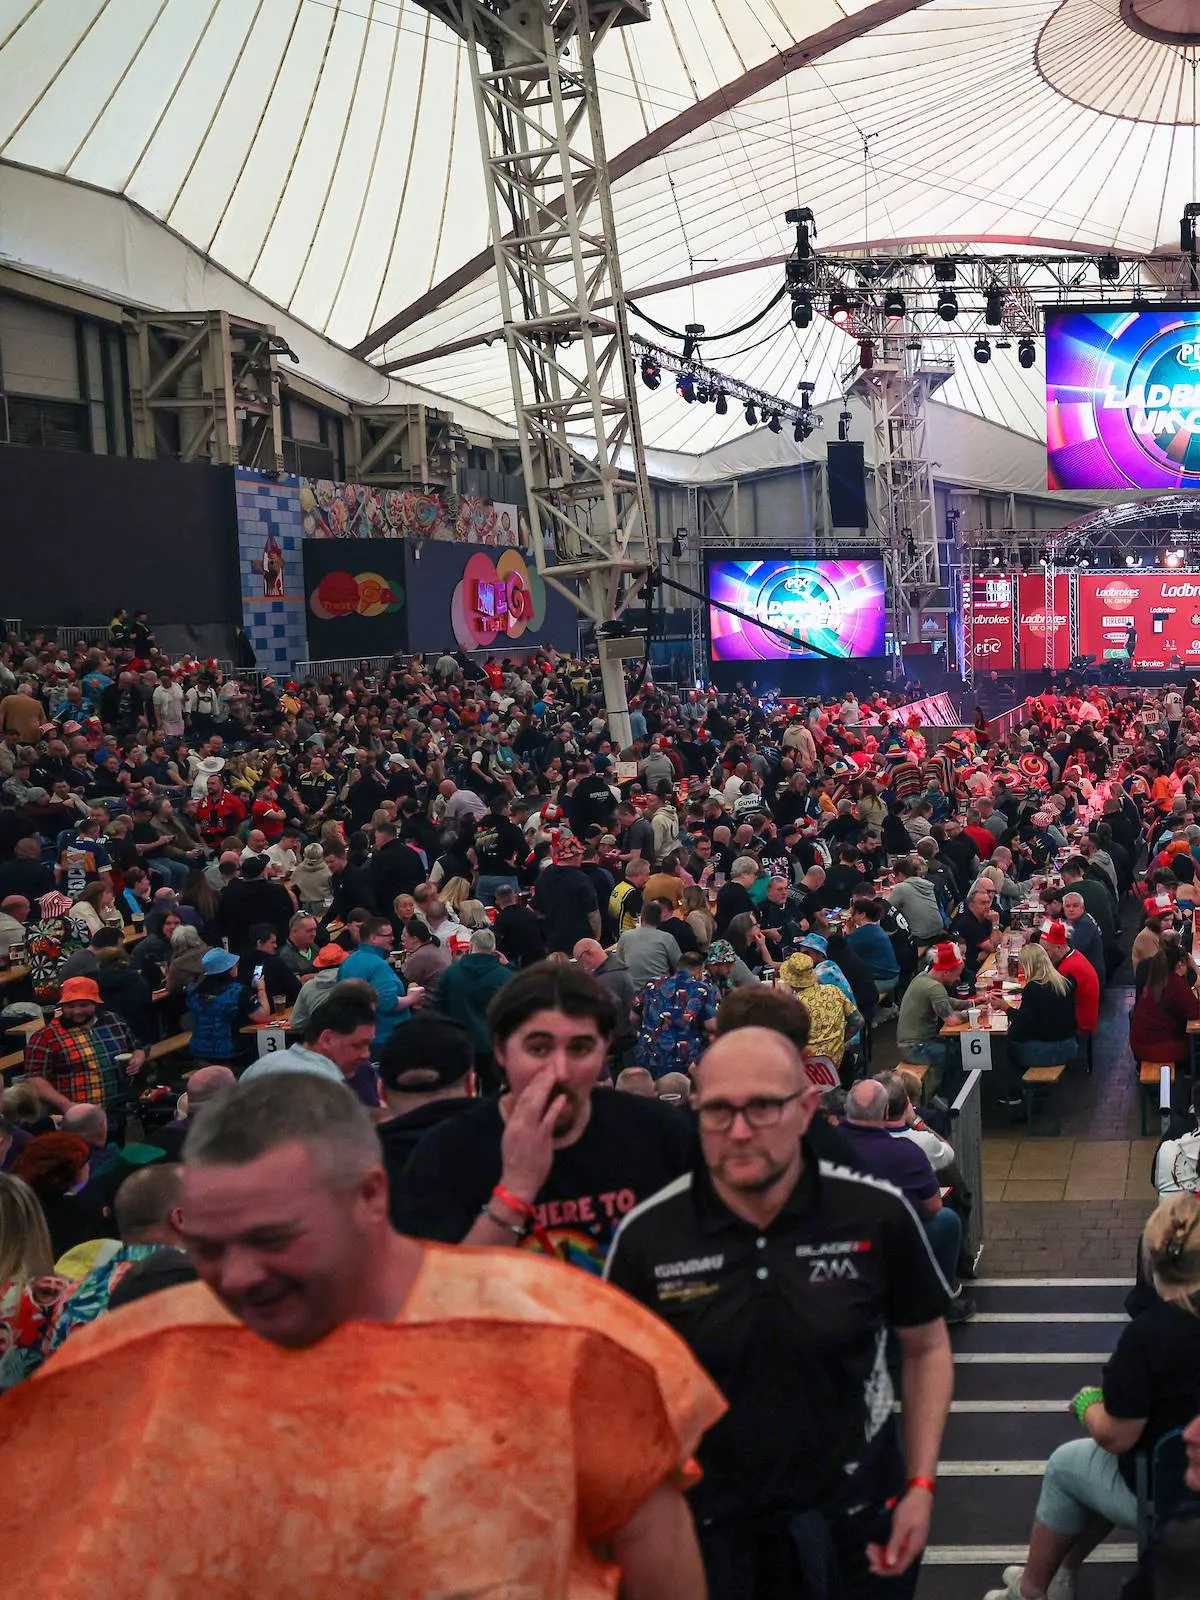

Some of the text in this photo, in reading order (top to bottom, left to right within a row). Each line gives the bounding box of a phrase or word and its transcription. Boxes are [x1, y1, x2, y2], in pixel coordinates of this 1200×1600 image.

[1132, 410, 1177, 434] UK
[1095, 587, 1140, 597] Ladbrokes
[266, 1036, 277, 1053] 3
[970, 1038, 982, 1056] 6
[598, 1187, 636, 1219] TO
